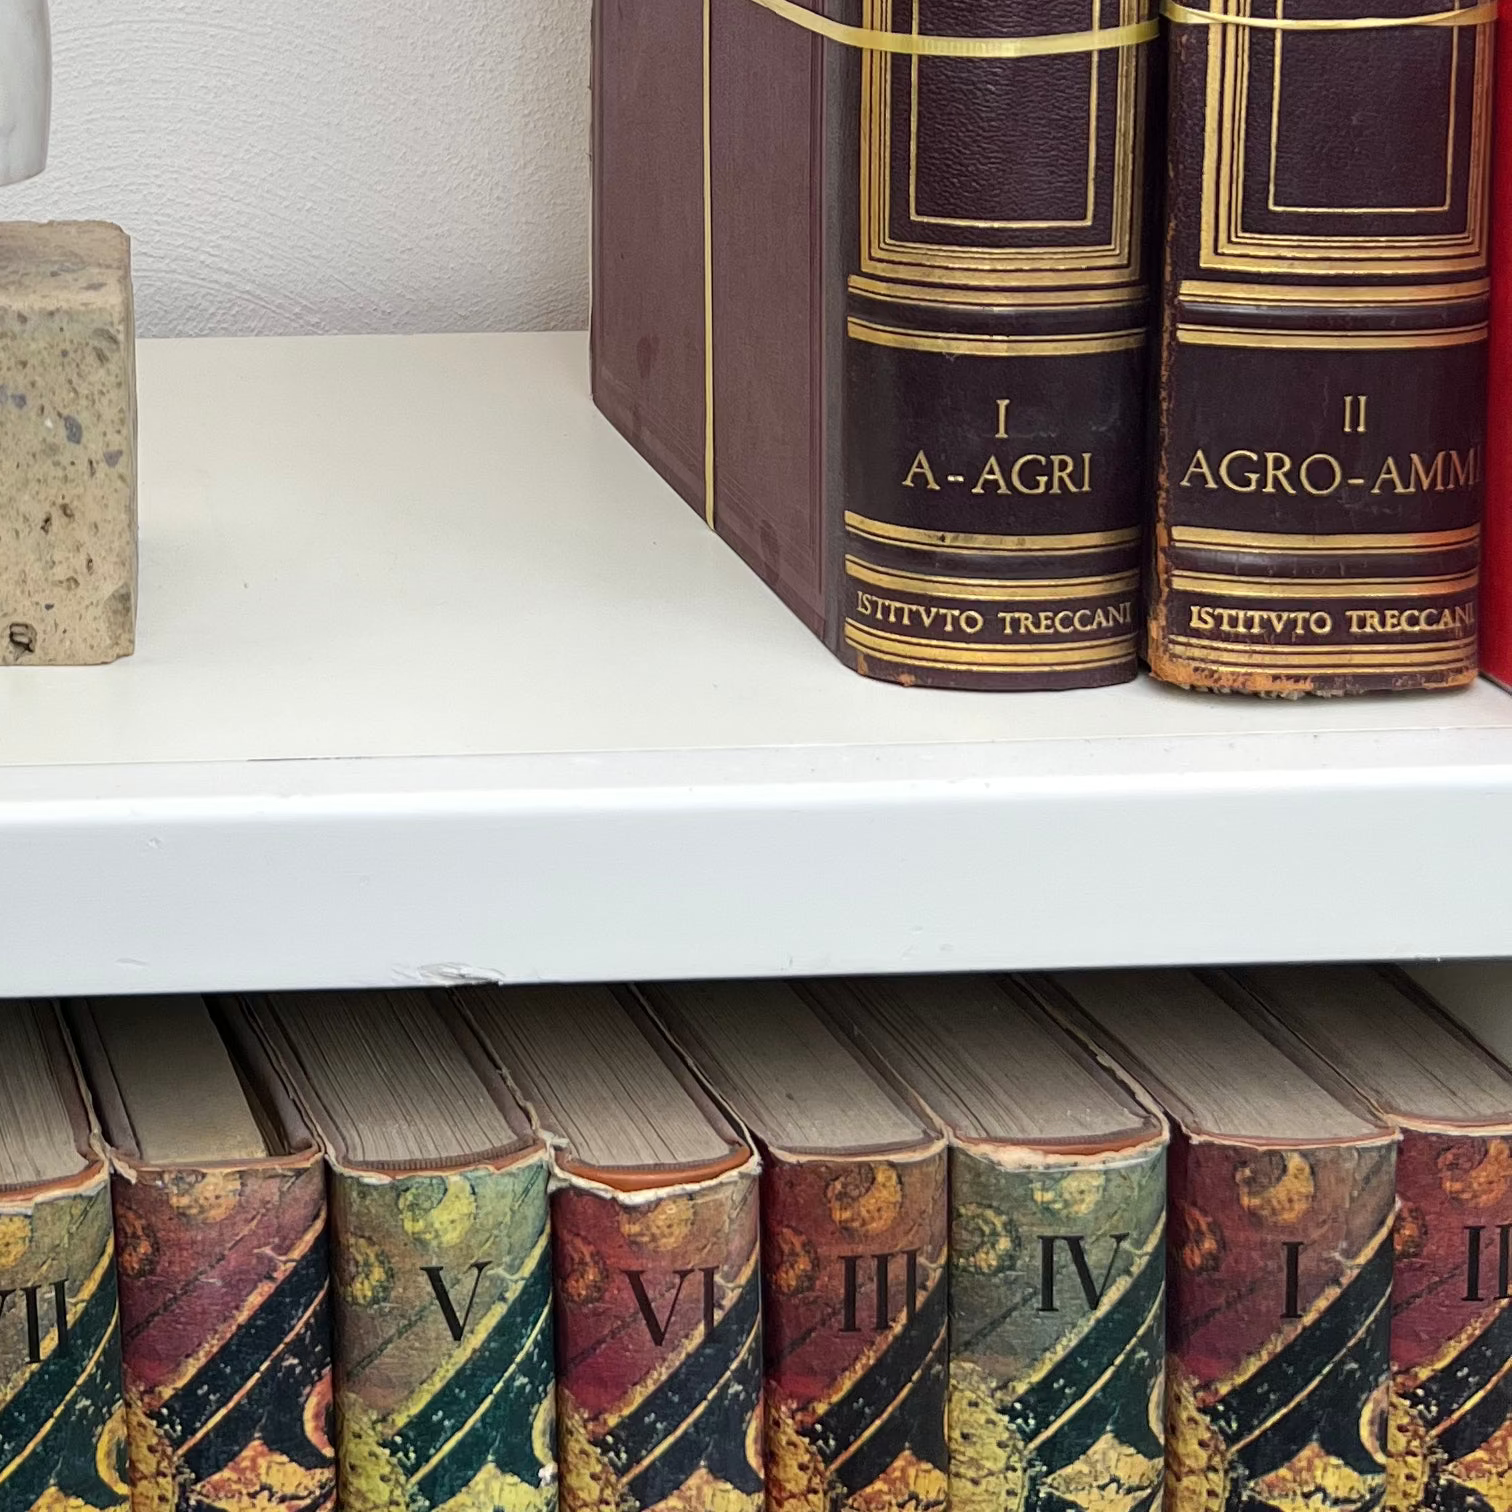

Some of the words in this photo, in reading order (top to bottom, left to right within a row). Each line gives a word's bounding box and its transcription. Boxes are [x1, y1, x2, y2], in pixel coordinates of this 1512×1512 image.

[995, 399, 1009, 438] I
[1344, 395, 1368, 433] II
[857, 591, 984, 633] ISTITVTO
[998, 600, 1133, 633] TRECCANI
[1190, 605, 1332, 633] ISTITVTO
[1345, 607, 1475, 633] TRECCANI
[420, 1261, 491, 1341] V
[620, 1263, 720, 1346] VI
[837, 1248, 919, 1331] III
[1036, 1232, 1127, 1312] IV
[1280, 1242, 1305, 1319] I
